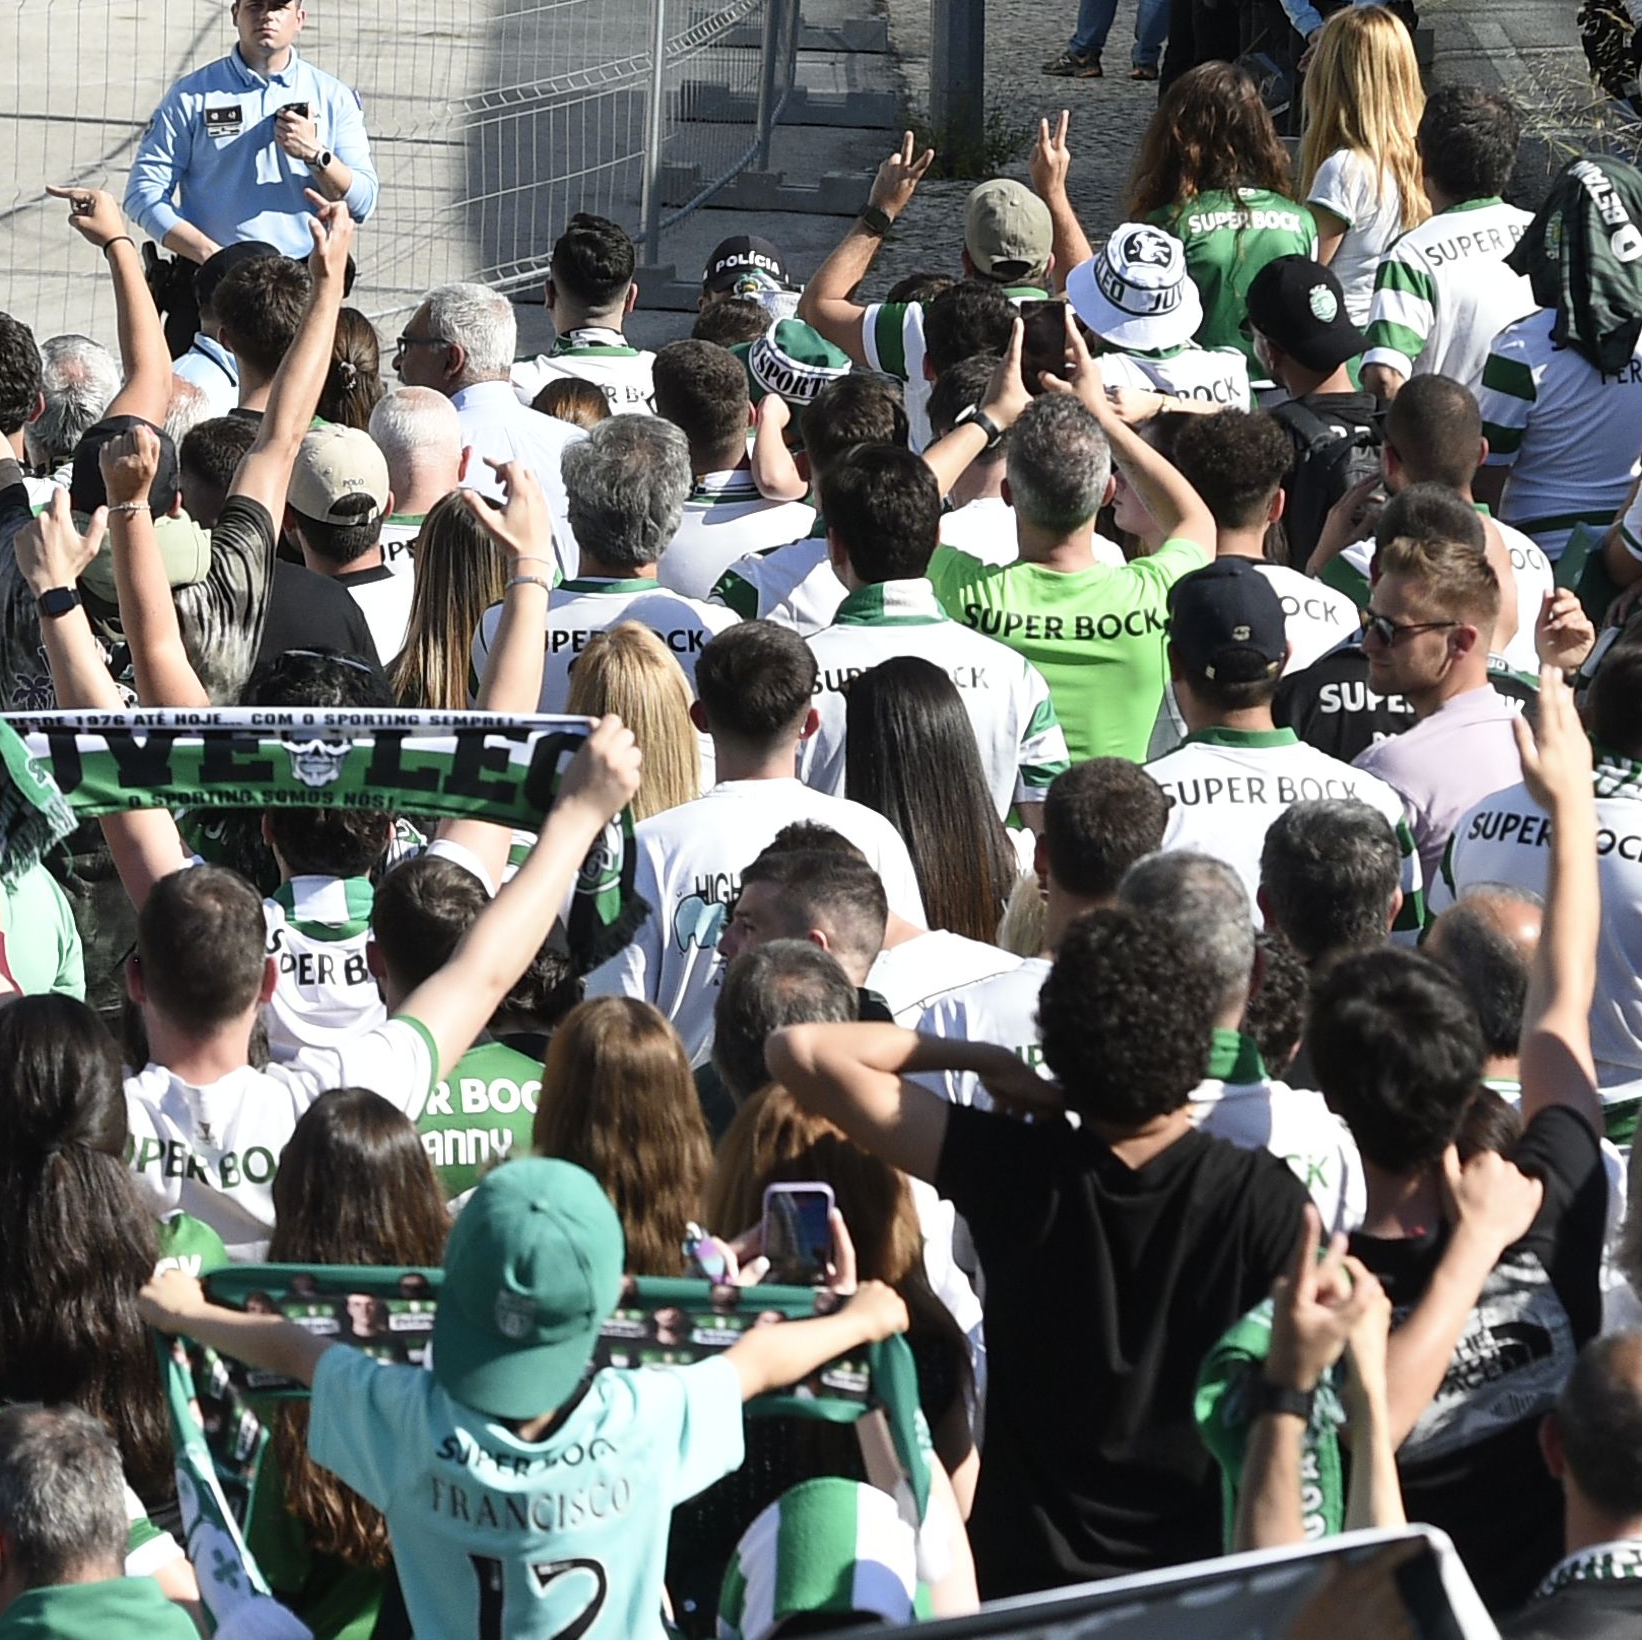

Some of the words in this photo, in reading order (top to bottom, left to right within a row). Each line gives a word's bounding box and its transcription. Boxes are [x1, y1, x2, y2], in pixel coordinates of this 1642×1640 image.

[1188, 210, 1247, 233] SUPER
[1251, 208, 1300, 232] BOCK
[716, 250, 780, 275] POLÍCIA
[1425, 227, 1501, 266] SUPER
[756, 354, 822, 398] SPORT
[965, 603, 1063, 642] SUPER
[1075, 605, 1165, 641] BOCK
[1280, 595, 1340, 626] OCK
[1320, 681, 1415, 715] SUPE
[74, 714, 126, 727] 1976
[133, 712, 166, 726] ATÉ
[252, 713, 294, 726] COM
[304, 714, 315, 726] O
[331, 714, 421, 727] SPORTING
[154, 790, 252, 807] SPORTING
[261, 790, 334, 805] SOMOS
[1160, 774, 1267, 809] SUPER
[460, 1077, 543, 1115] BOC
[220, 1144, 278, 1189] BO
[432, 1472, 631, 1532] FRANCISCO
